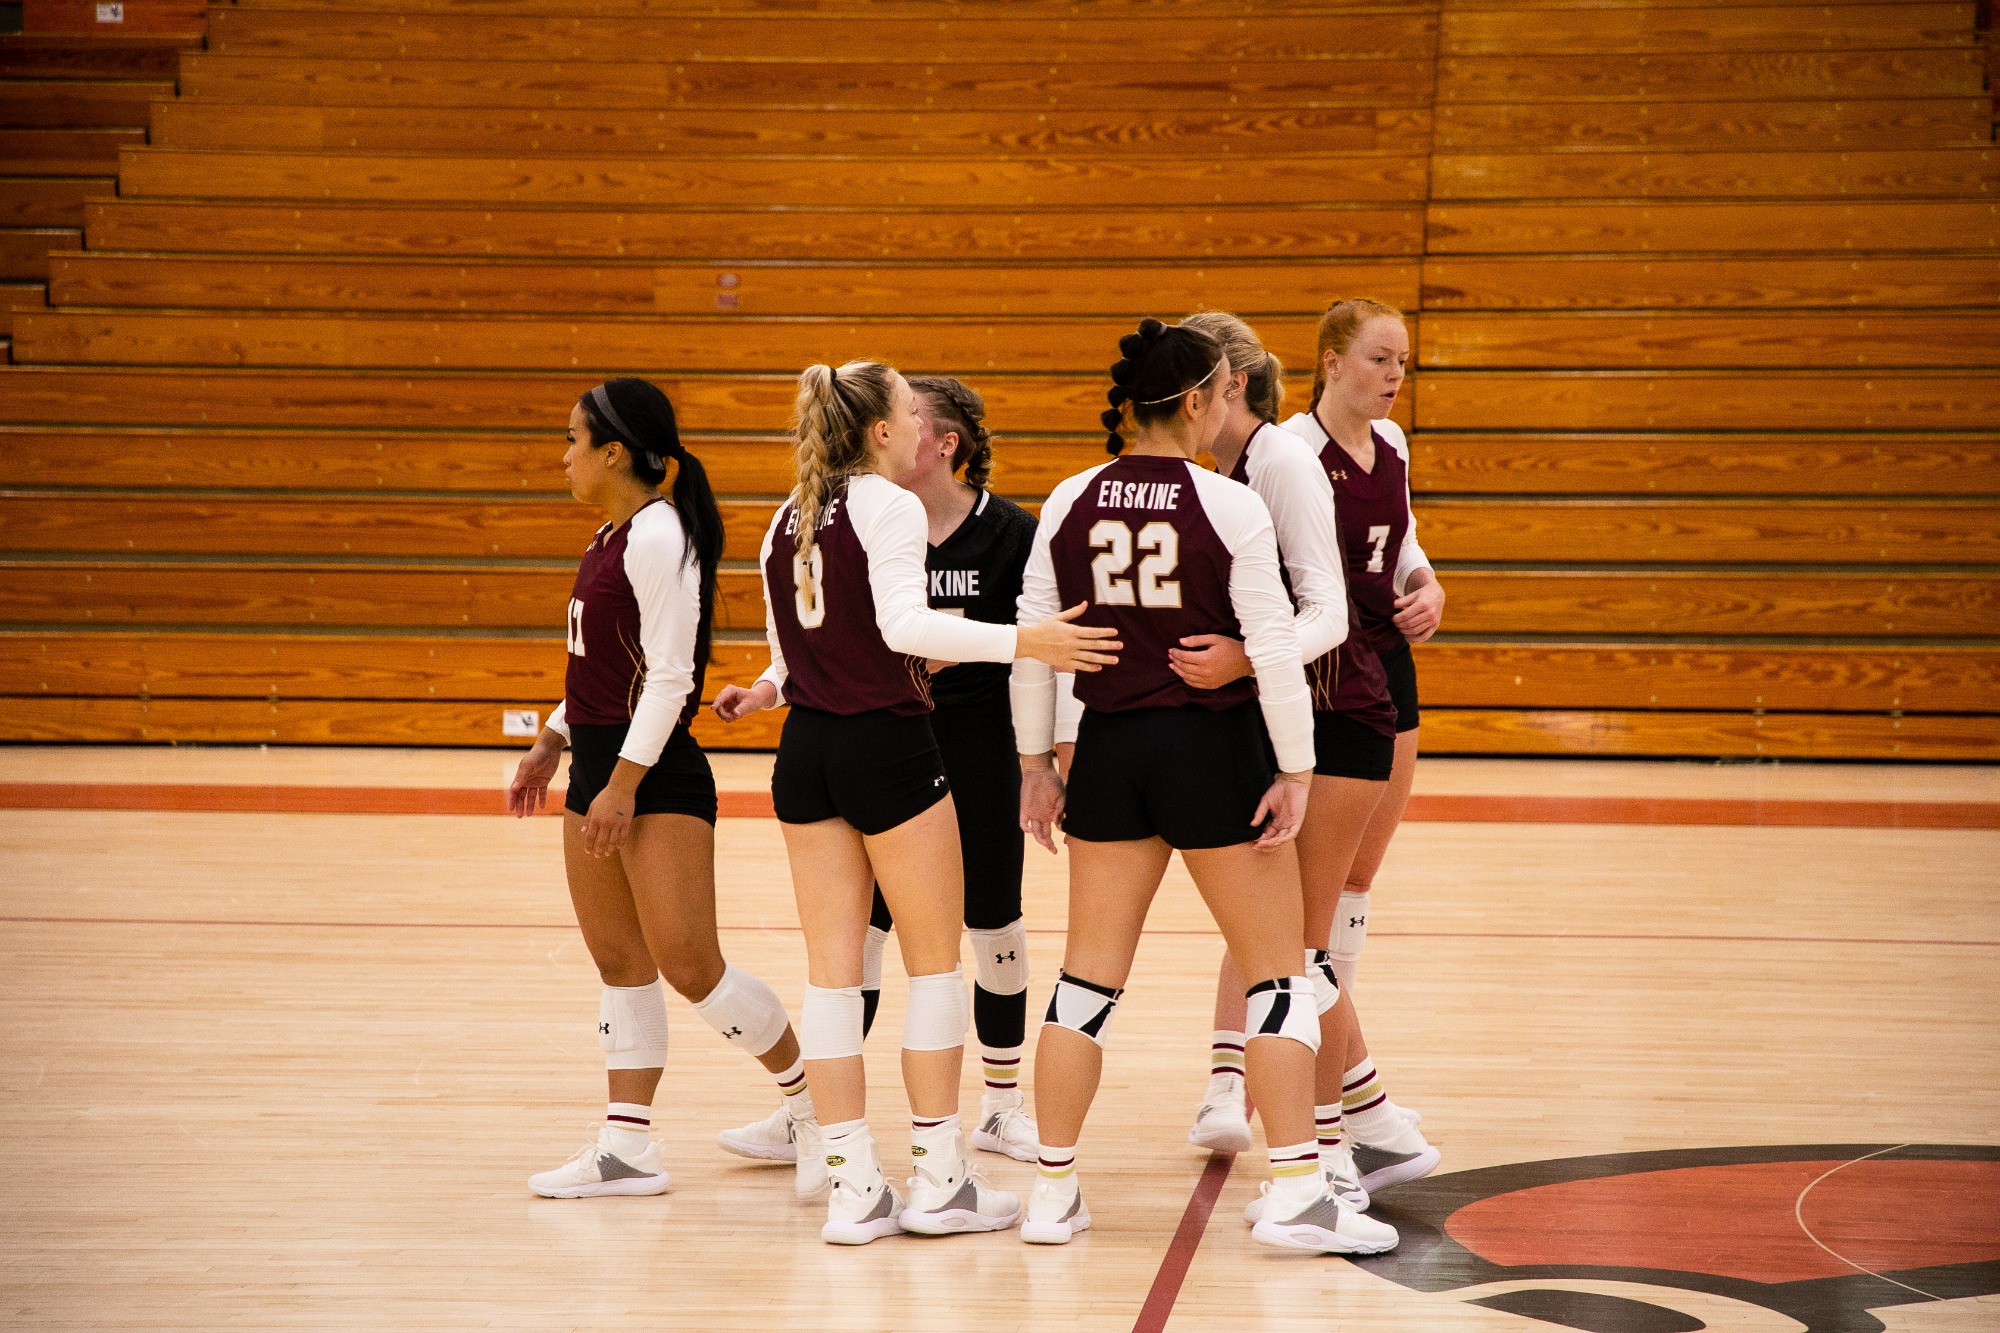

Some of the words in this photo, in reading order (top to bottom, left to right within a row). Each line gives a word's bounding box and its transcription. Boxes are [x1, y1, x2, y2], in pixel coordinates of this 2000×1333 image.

[1097, 480, 1181, 510] ERSKINE
[1088, 519, 1182, 608] 22
[1365, 525, 1391, 573] 7
[930, 570, 980, 597] KINE
